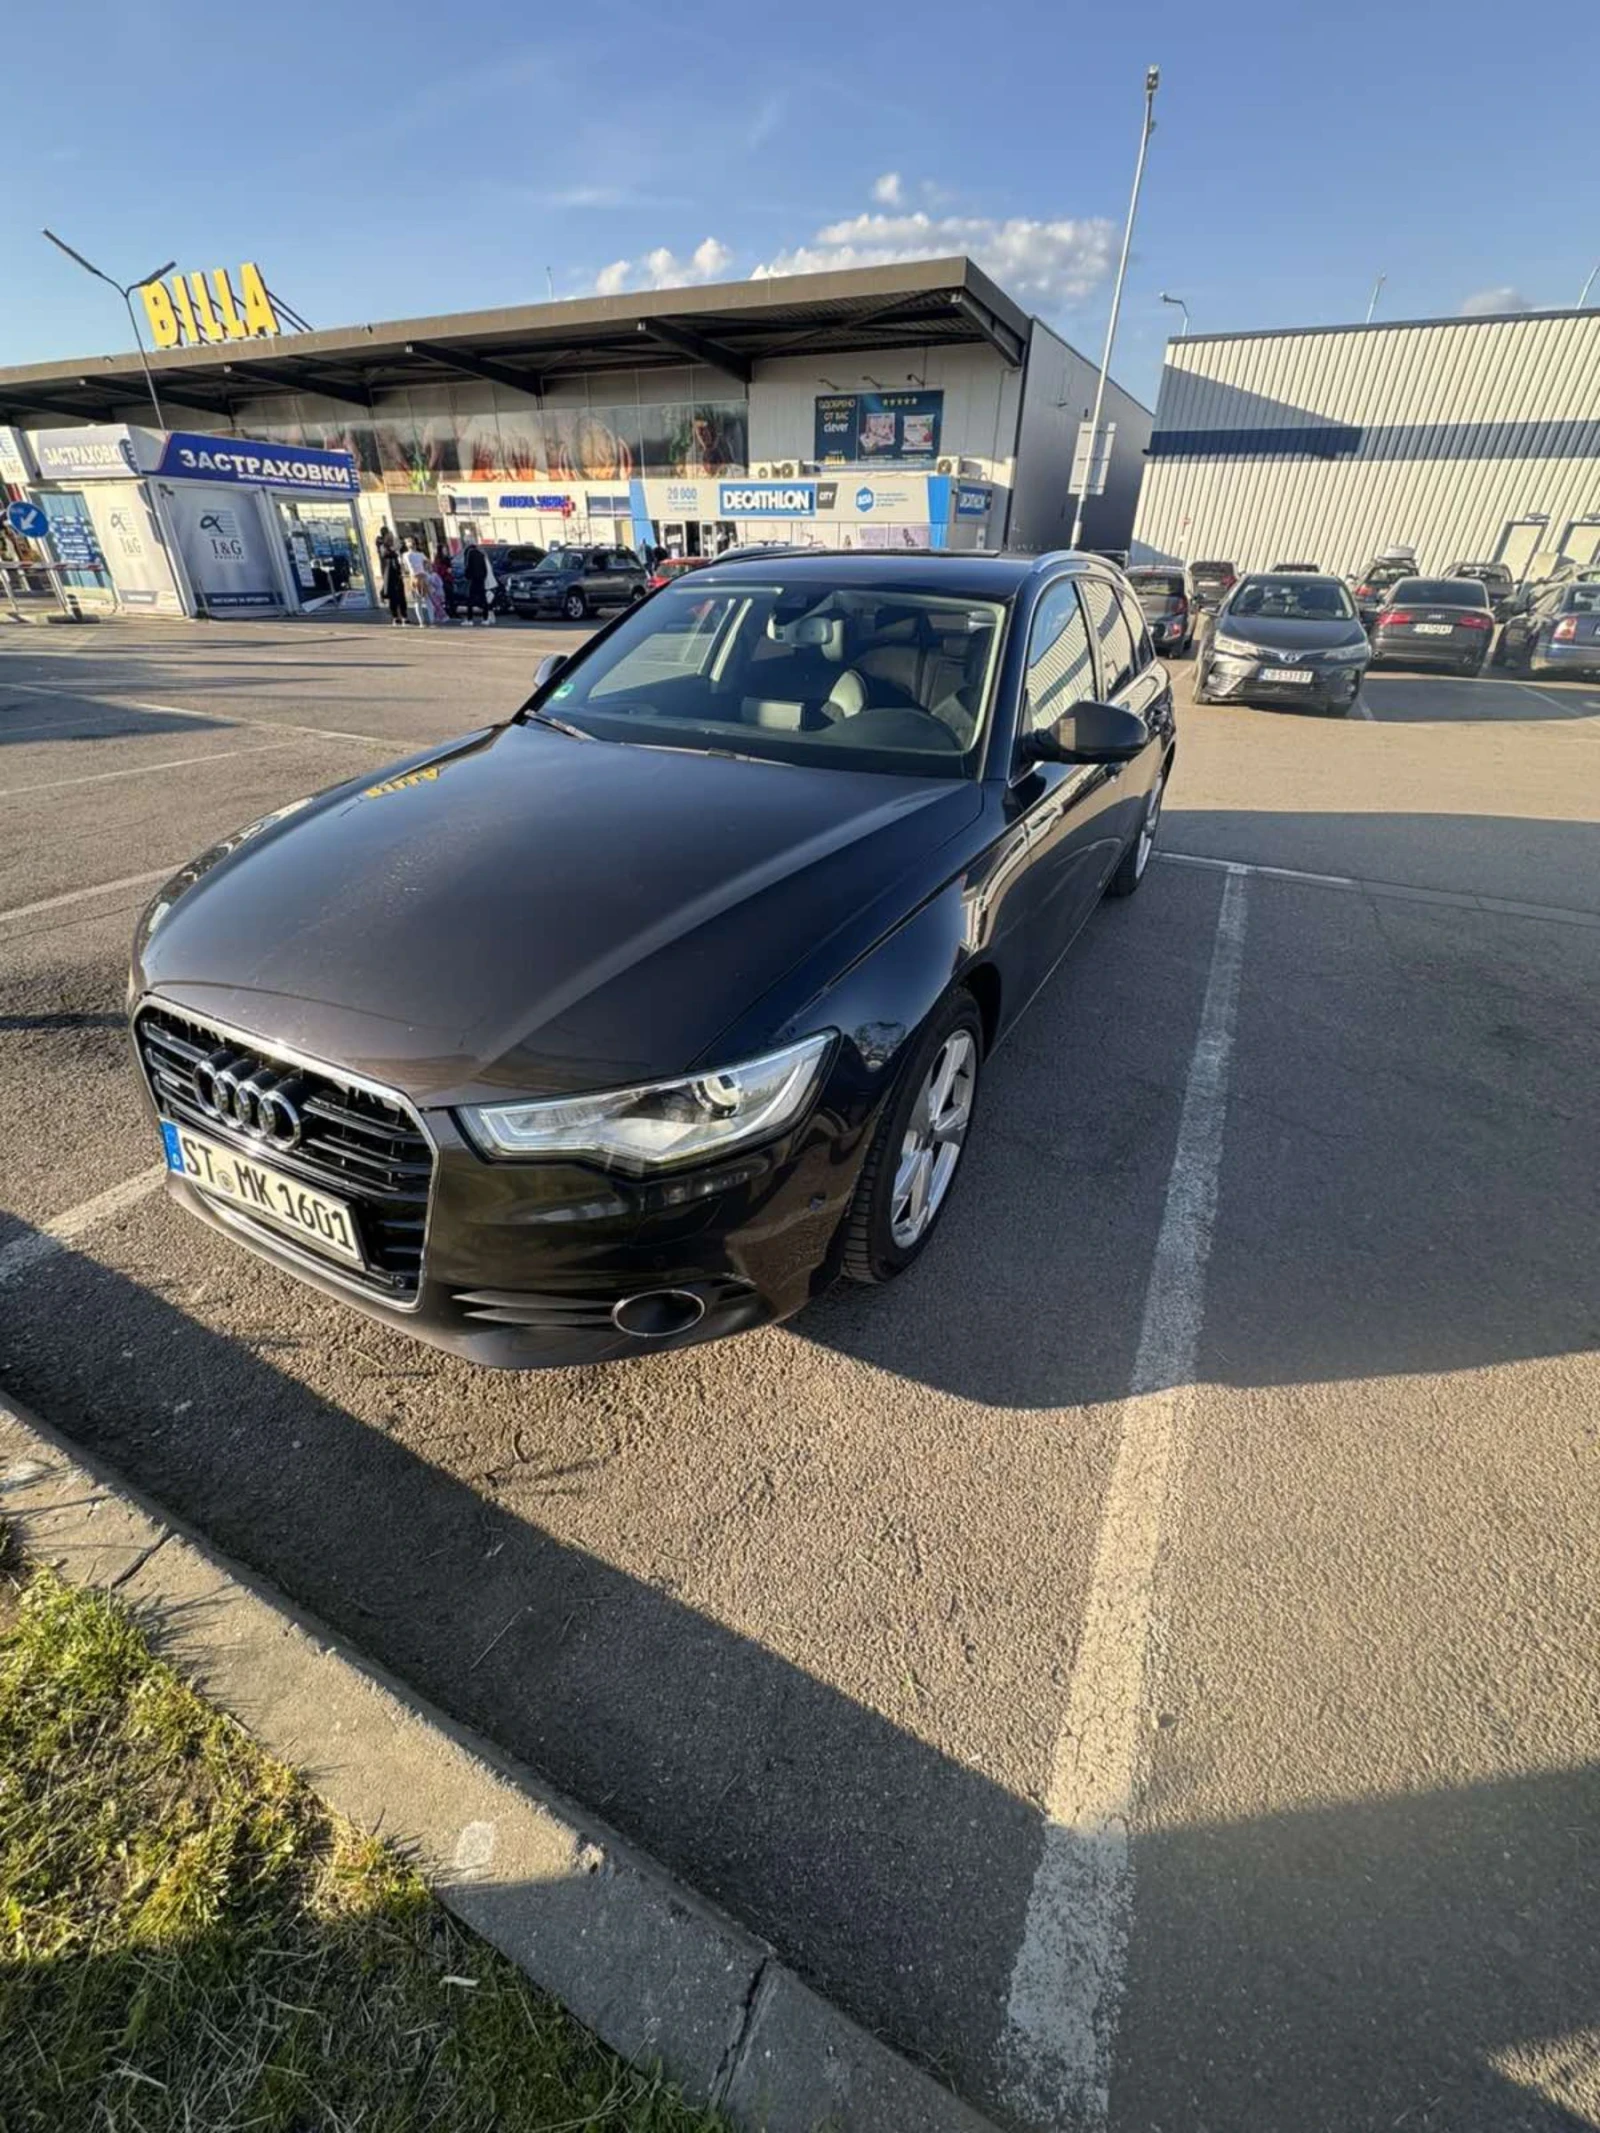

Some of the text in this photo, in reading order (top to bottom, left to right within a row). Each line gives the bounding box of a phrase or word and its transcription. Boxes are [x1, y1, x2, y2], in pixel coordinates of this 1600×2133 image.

[140, 261, 279, 347] BILLA
[179, 448, 350, 483] ЗАСТРАХОВКИ
[722, 489, 809, 512] DECATHLON
[818, 492, 834, 502] CITY
[210, 538, 243, 556] I&G
[181, 1136, 214, 1184] ST
[233, 1159, 277, 1212] MK
[277, 1182, 355, 1253] 1601
